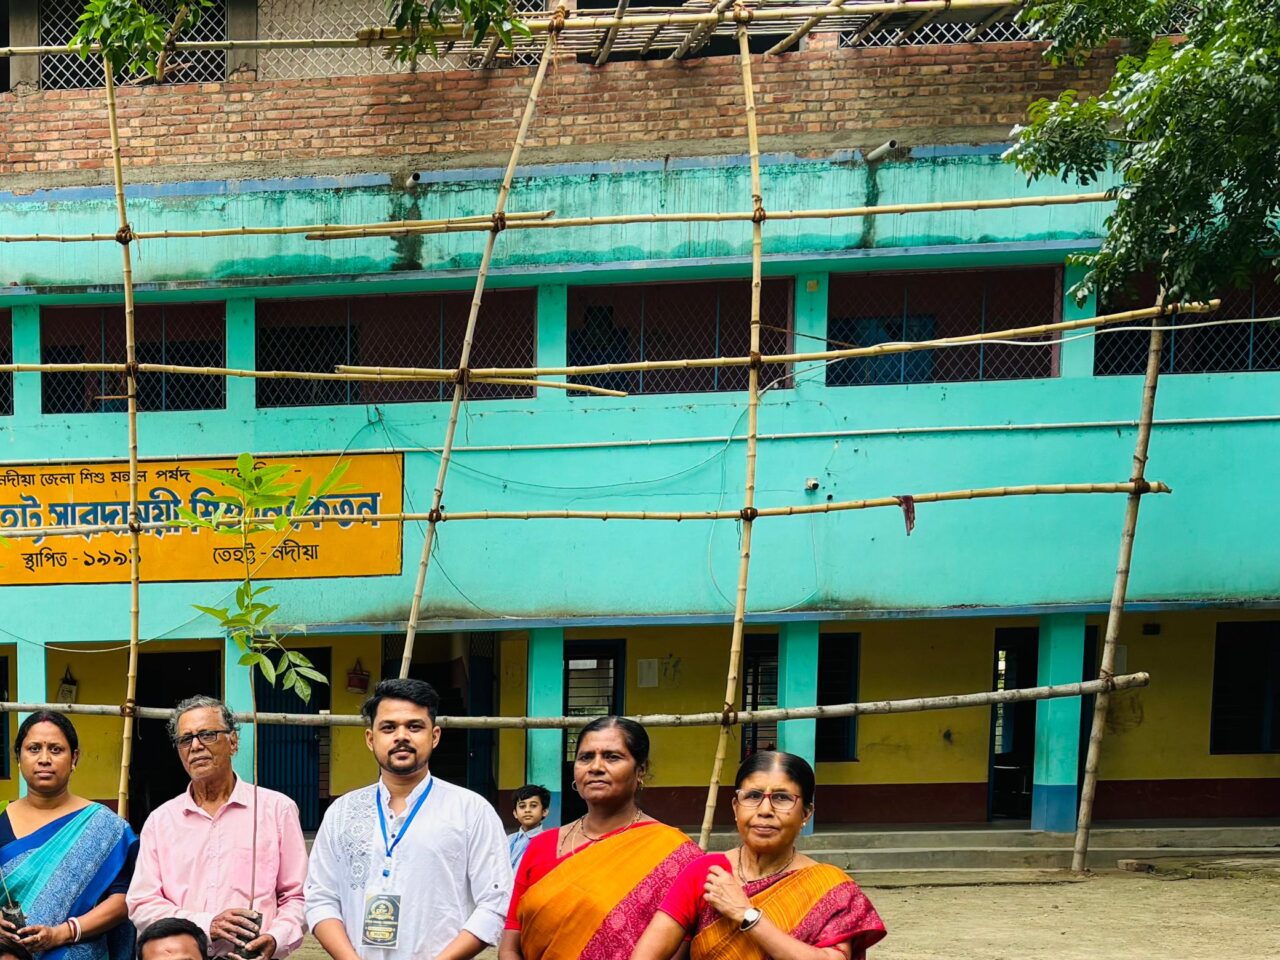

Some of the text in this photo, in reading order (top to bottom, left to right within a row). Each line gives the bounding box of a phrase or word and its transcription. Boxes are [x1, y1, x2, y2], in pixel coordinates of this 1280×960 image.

[40, 473, 74, 486] জেলা
[79, 468, 105, 485] শিশু
[155, 466, 192, 483] পর্ষদ
[271, 539, 320, 563] নদীয়া
